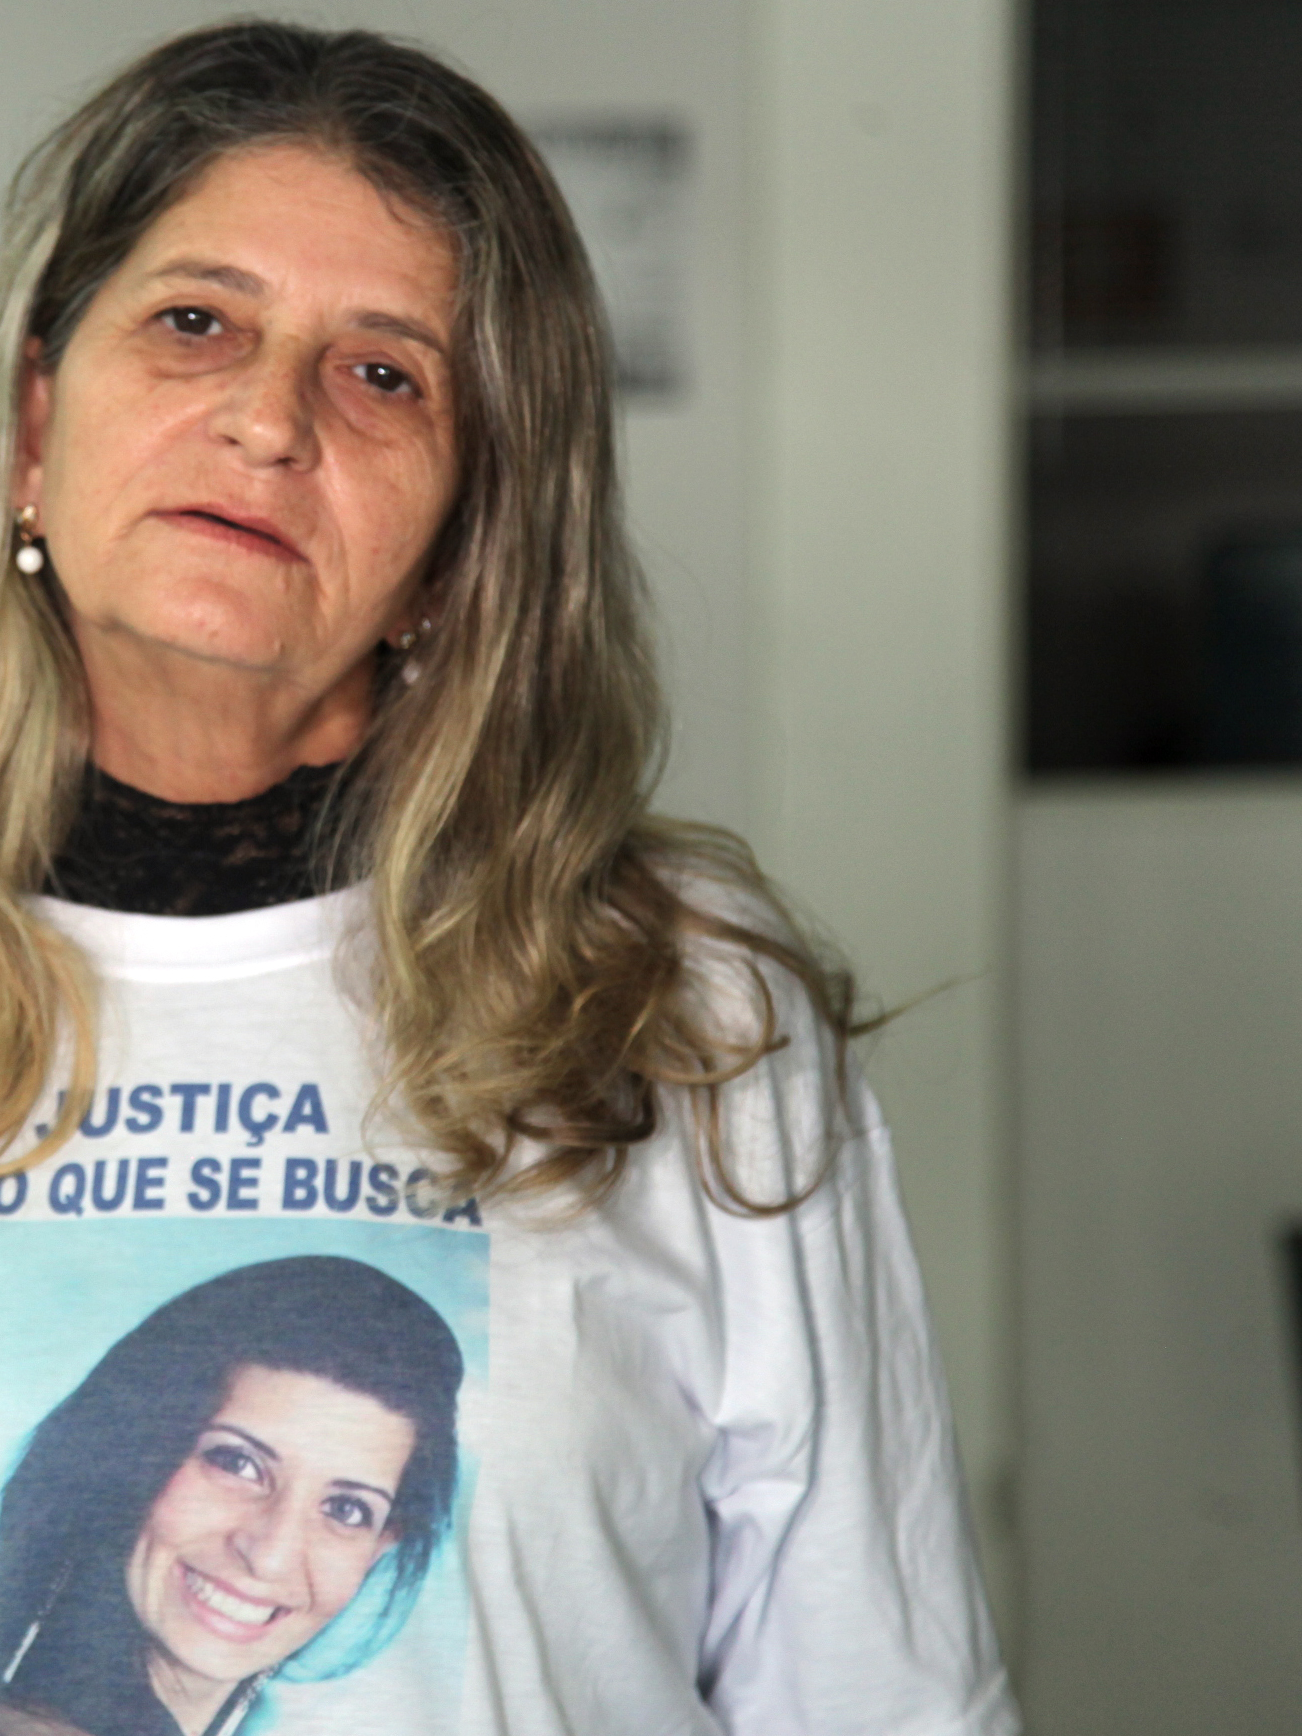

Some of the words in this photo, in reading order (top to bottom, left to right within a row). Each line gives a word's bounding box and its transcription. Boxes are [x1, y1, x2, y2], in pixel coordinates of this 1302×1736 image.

[48, 1156, 169, 1218] QUE
[187, 1156, 263, 1213] SE
[281, 1156, 483, 1228] BUSCA
